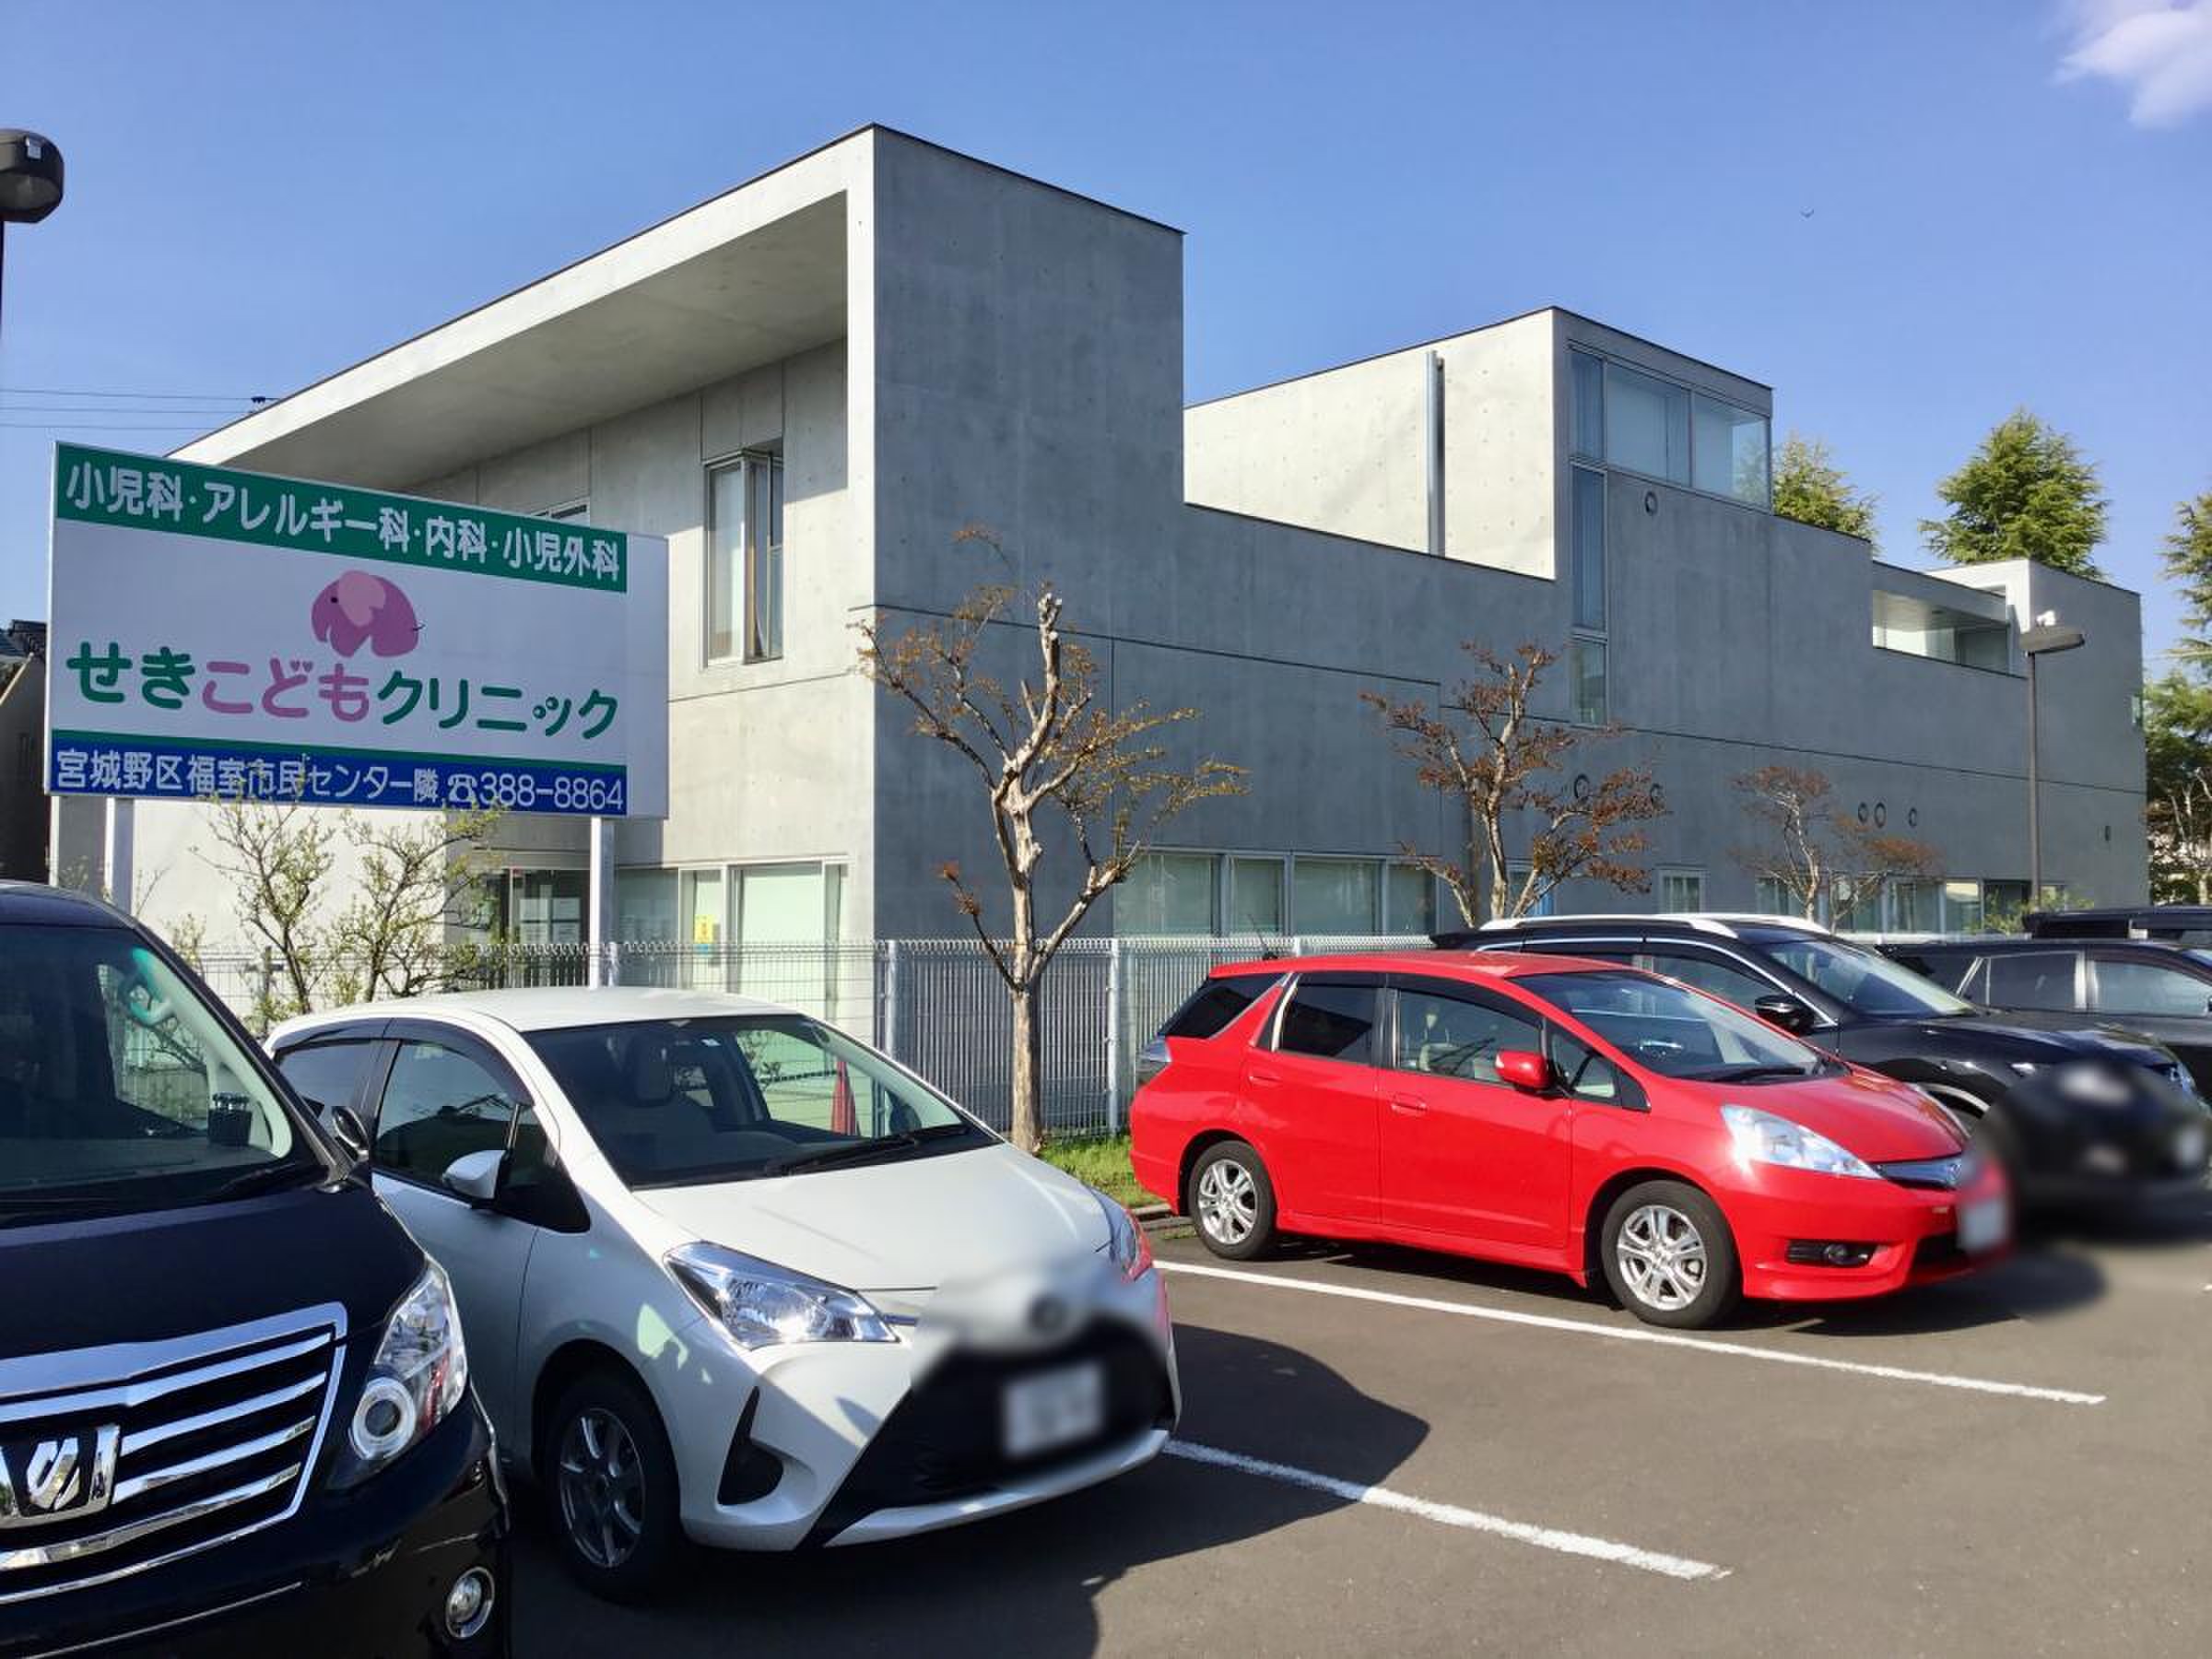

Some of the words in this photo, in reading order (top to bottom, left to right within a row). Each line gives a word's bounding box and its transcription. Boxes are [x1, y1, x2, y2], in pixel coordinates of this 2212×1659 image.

[66, 641, 618, 739] せきこどもクリニック
[56, 747, 439, 803] 宮城野区福室市民センター隣
[480, 771, 624, 810] 388-8864
